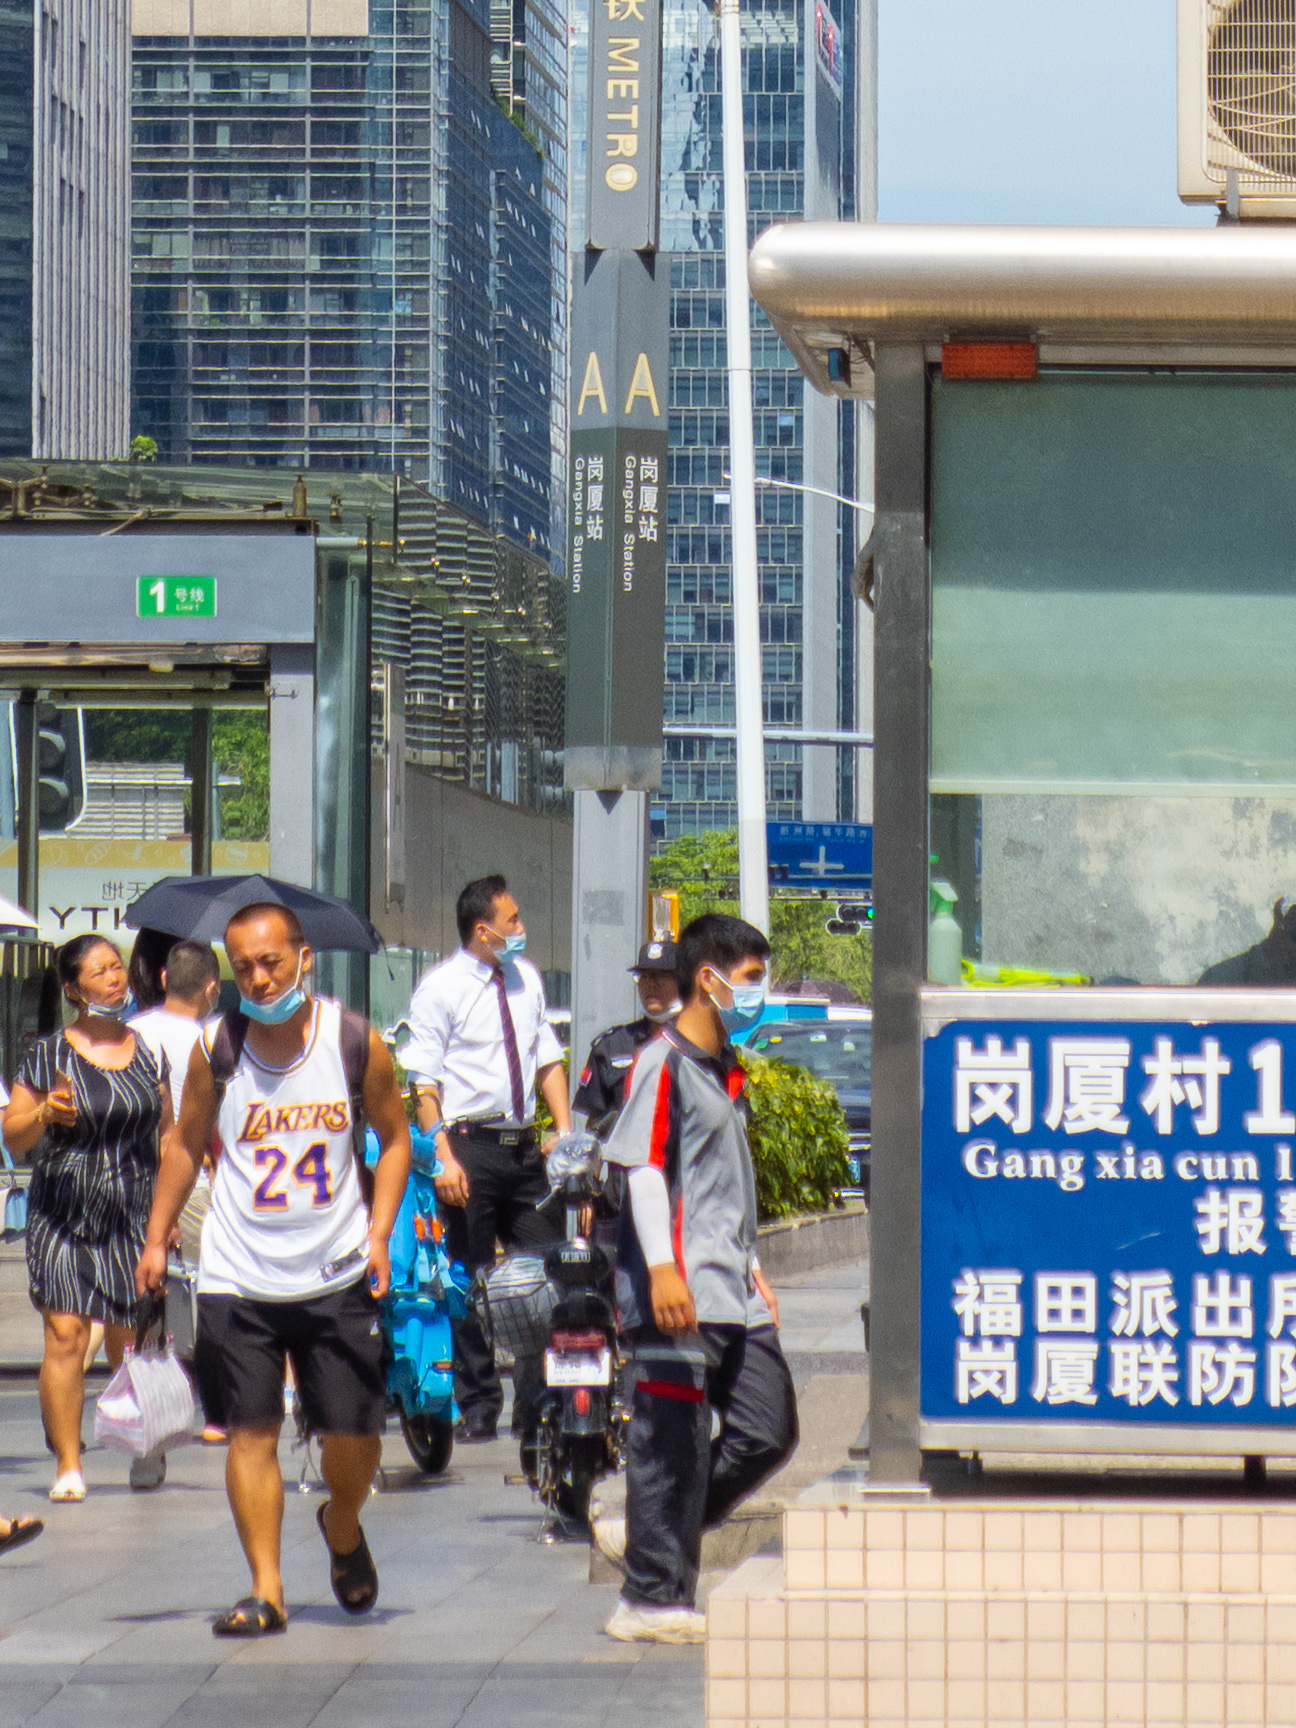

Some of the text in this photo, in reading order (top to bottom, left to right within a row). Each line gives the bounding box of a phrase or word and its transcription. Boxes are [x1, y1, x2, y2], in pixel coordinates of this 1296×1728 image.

[605, 35, 640, 192] METRO
[577, 351, 608, 416] A
[624, 352, 661, 417] A
[572, 456, 585, 594] Gangxia Station
[587, 455, 604, 541] 岗厦站
[622, 455, 637, 592] Gangxia Station
[638, 456, 659, 543] 岗厦站
[236, 1100, 350, 1144] LAKERS
[252, 1141, 332, 1212] 24
[964, 1142, 1085, 1192] Gang
[1095, 1144, 1164, 1182] xia
[1176, 1152, 1260, 1182] cun
